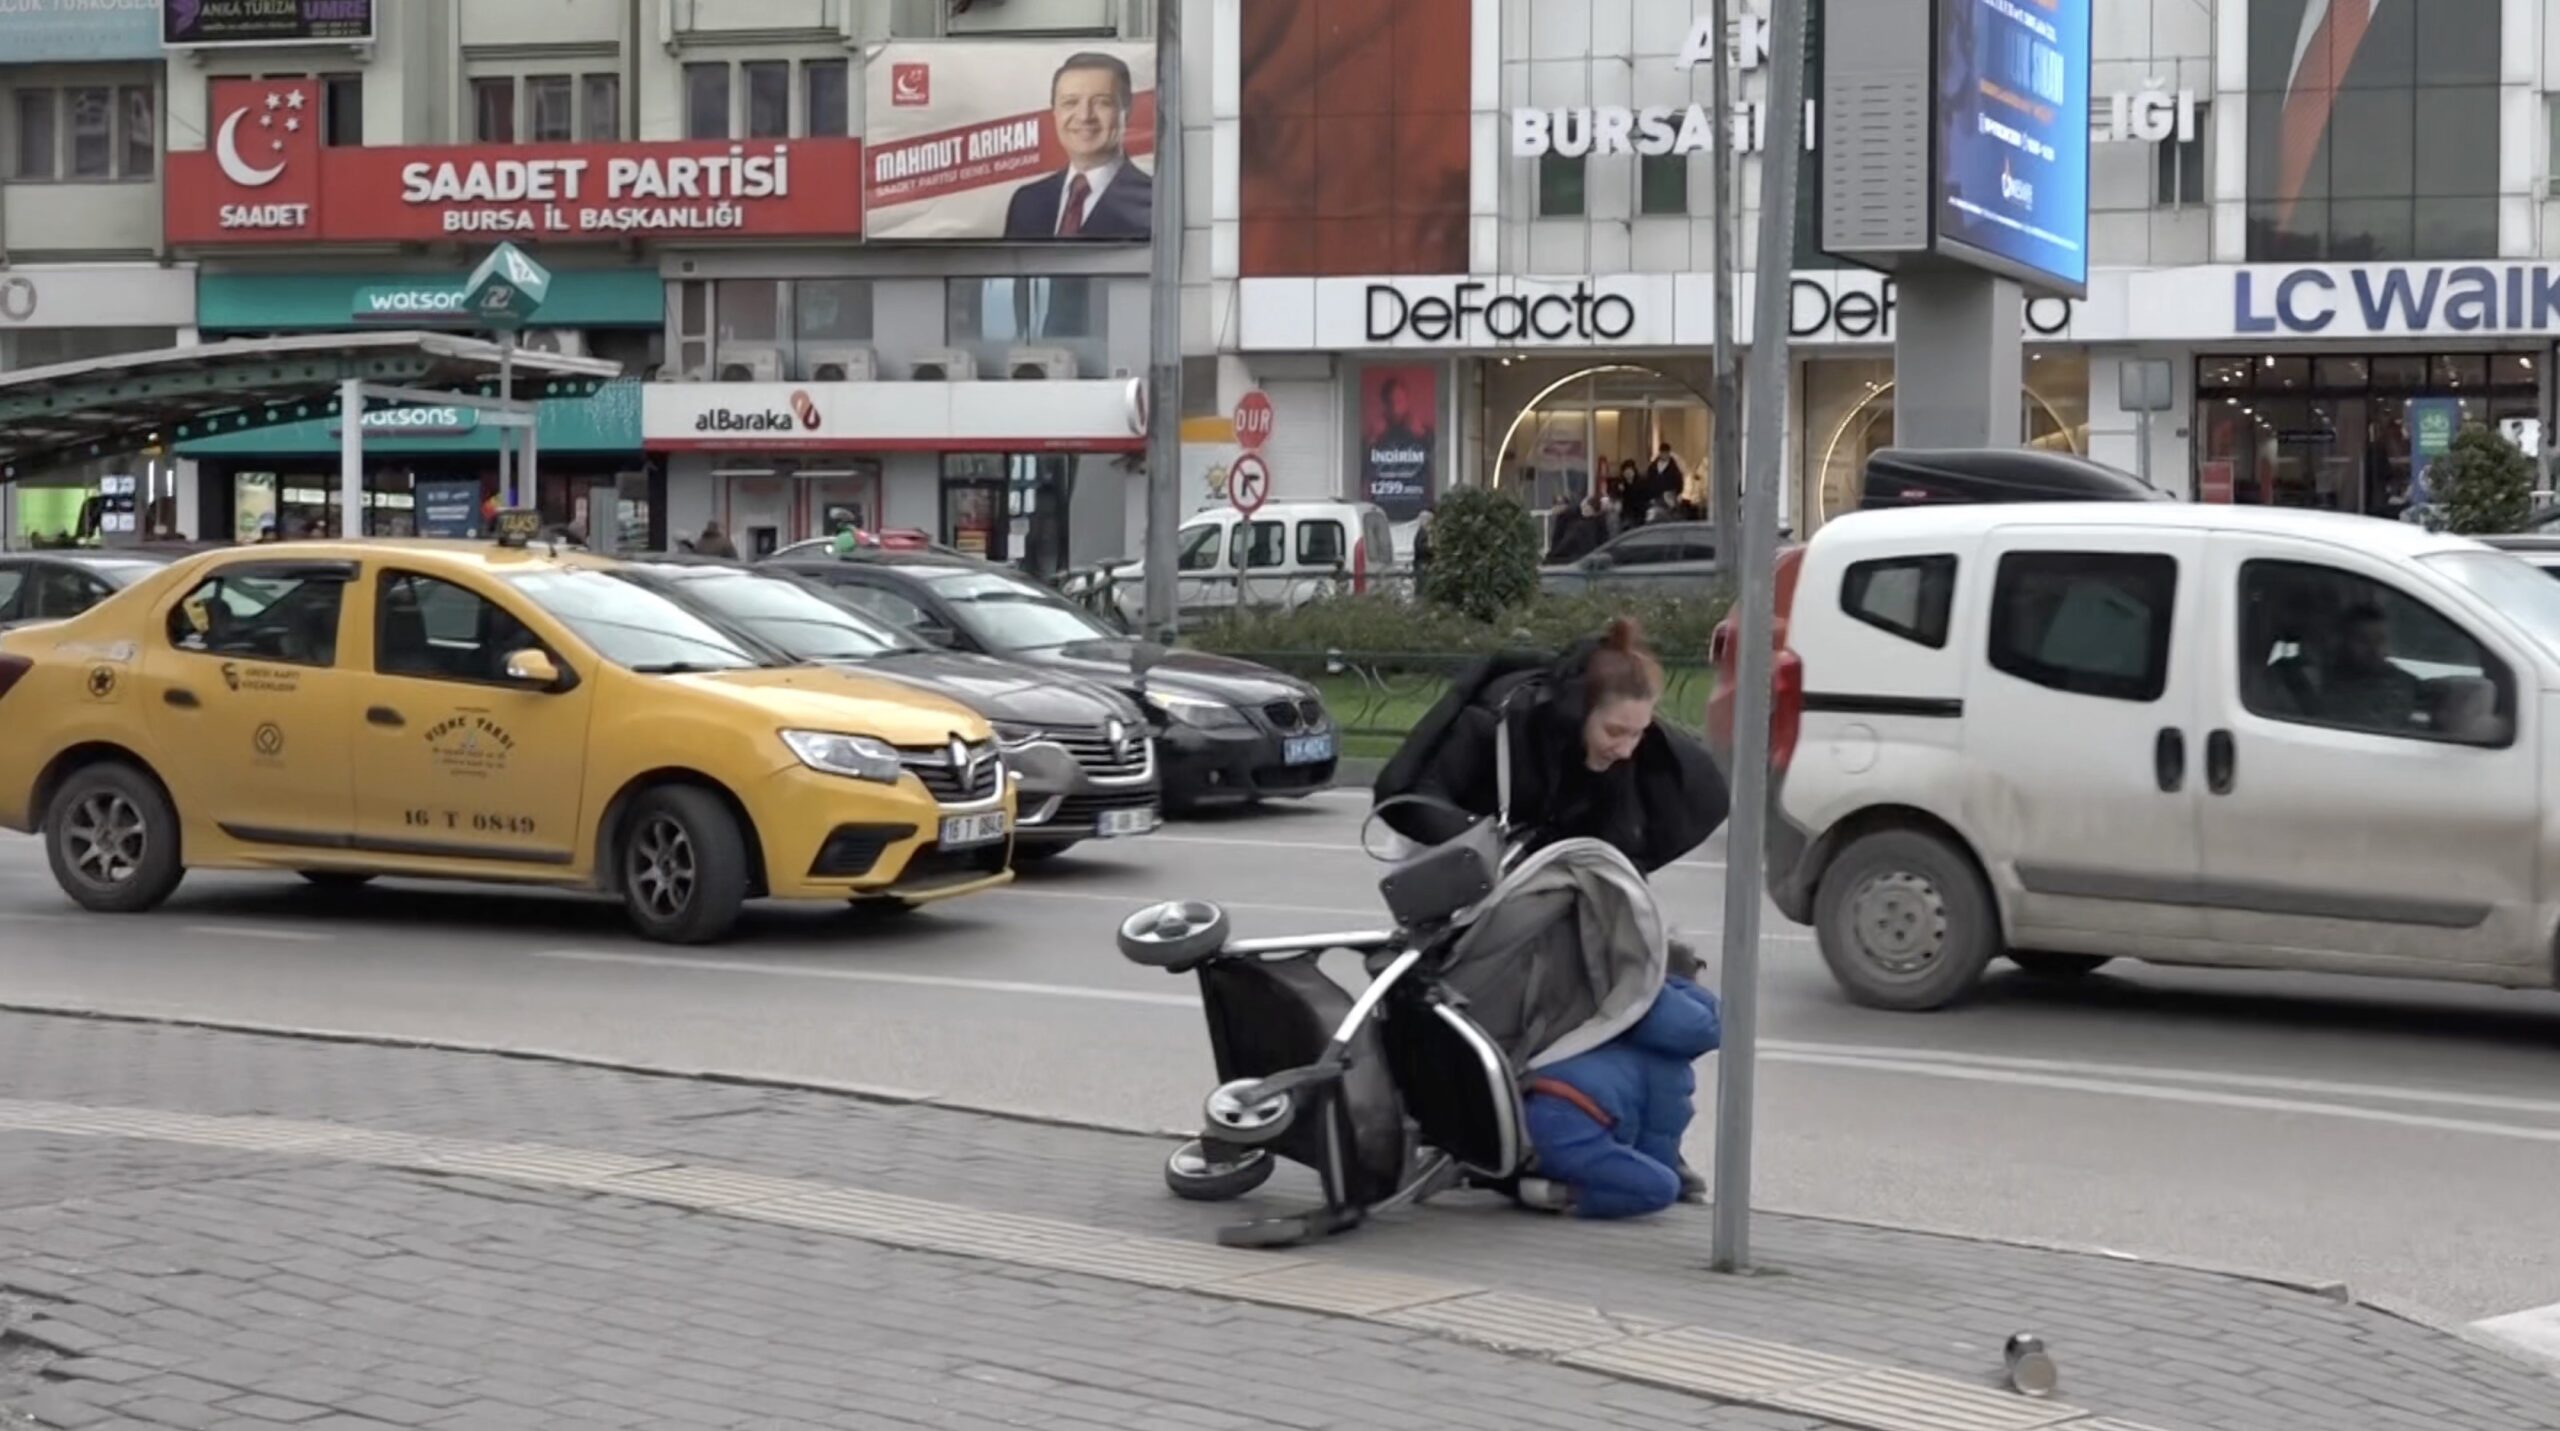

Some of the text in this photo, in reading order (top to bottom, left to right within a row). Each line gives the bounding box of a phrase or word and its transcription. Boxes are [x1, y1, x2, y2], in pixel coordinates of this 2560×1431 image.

[1513, 103, 1713, 156] BURSA
[875, 119, 1039, 183] MAHMUT ARIKAN
[402, 145, 787, 202] SAADET PARTİSİ
[219, 204, 309, 228] SAADET
[444, 201, 743, 231] BURSA İL BAŞKANLIĞI
[1366, 281, 1635, 342] DeFacto
[2234, 268, 2337, 332] LC
[695, 408, 793, 431] alBaraka
[1236, 409, 1271, 432] DUR
[405, 809, 535, 834] 16 T 0849
